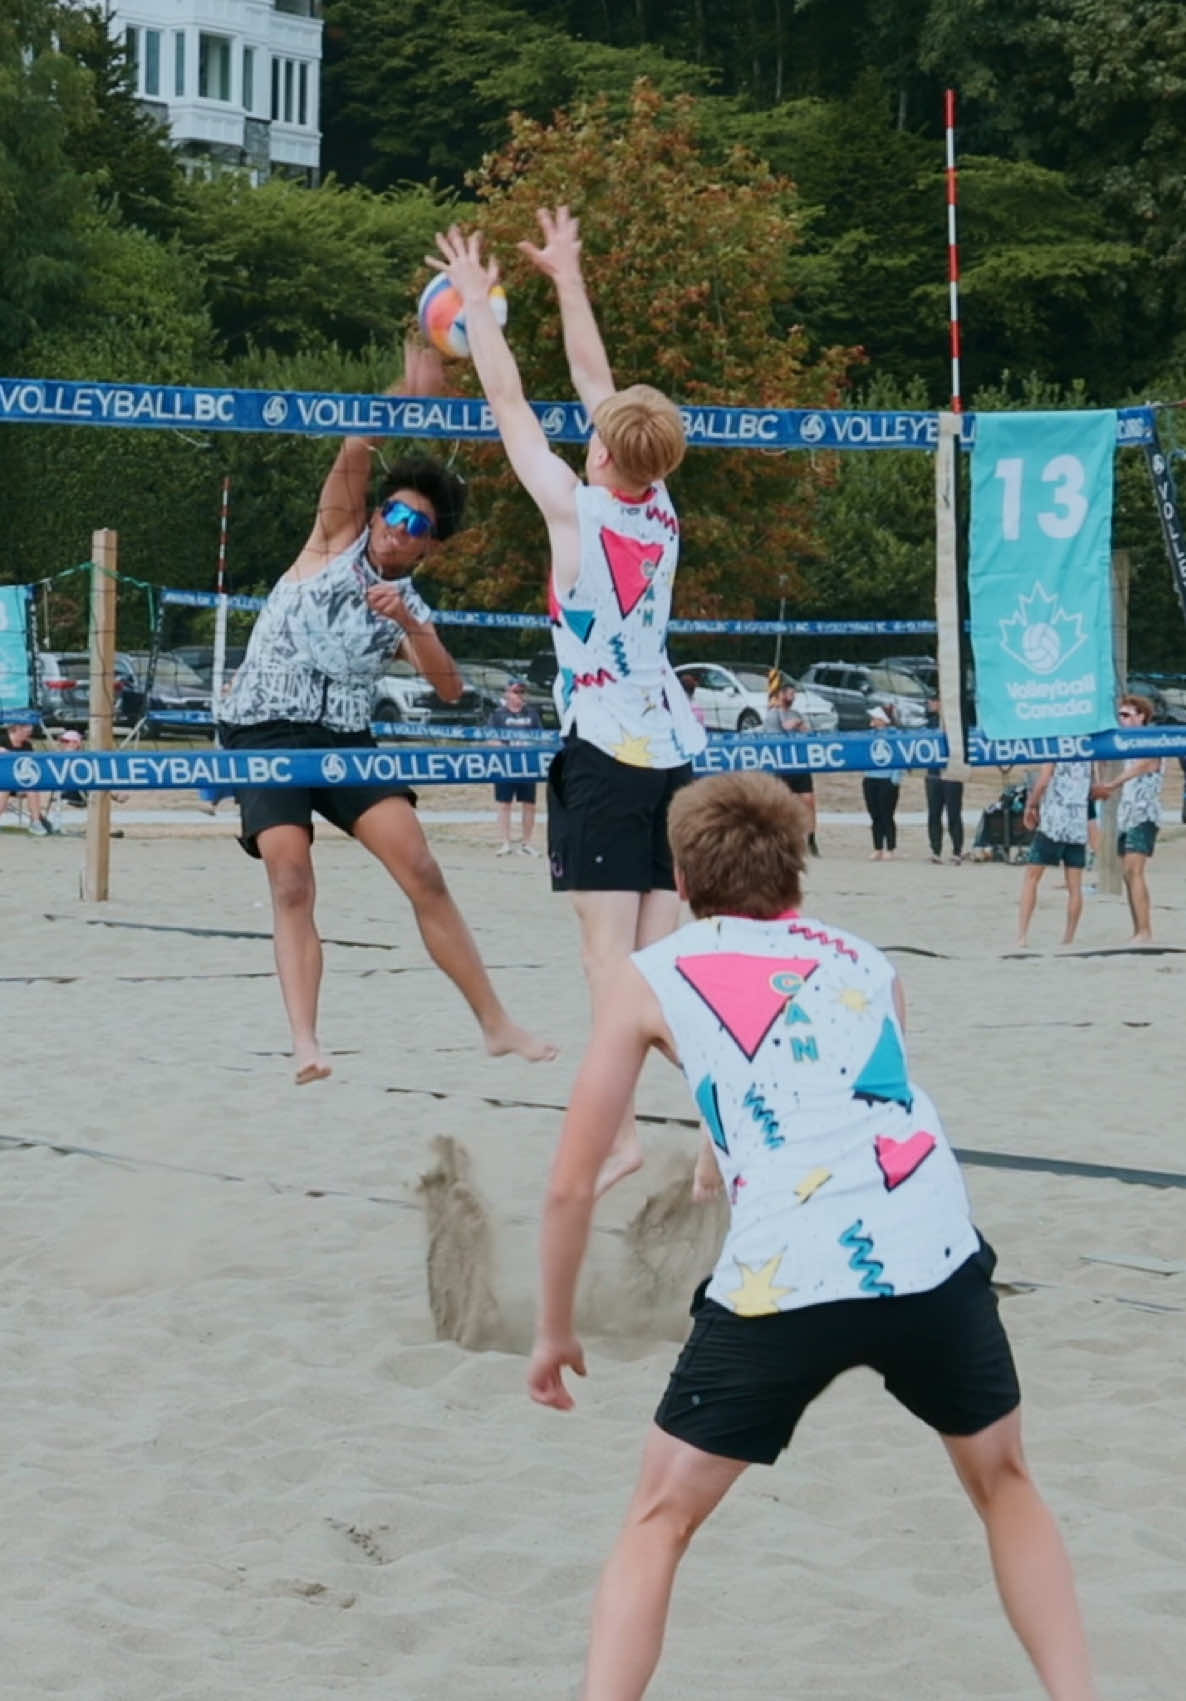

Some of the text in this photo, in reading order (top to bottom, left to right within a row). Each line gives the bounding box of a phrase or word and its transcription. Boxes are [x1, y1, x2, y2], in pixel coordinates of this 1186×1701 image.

[995, 454, 1089, 541] 13
[1005, 674, 1096, 700] Volleyball
[1016, 700, 1093, 720] Canada
[770, 972, 819, 1063] CAN
